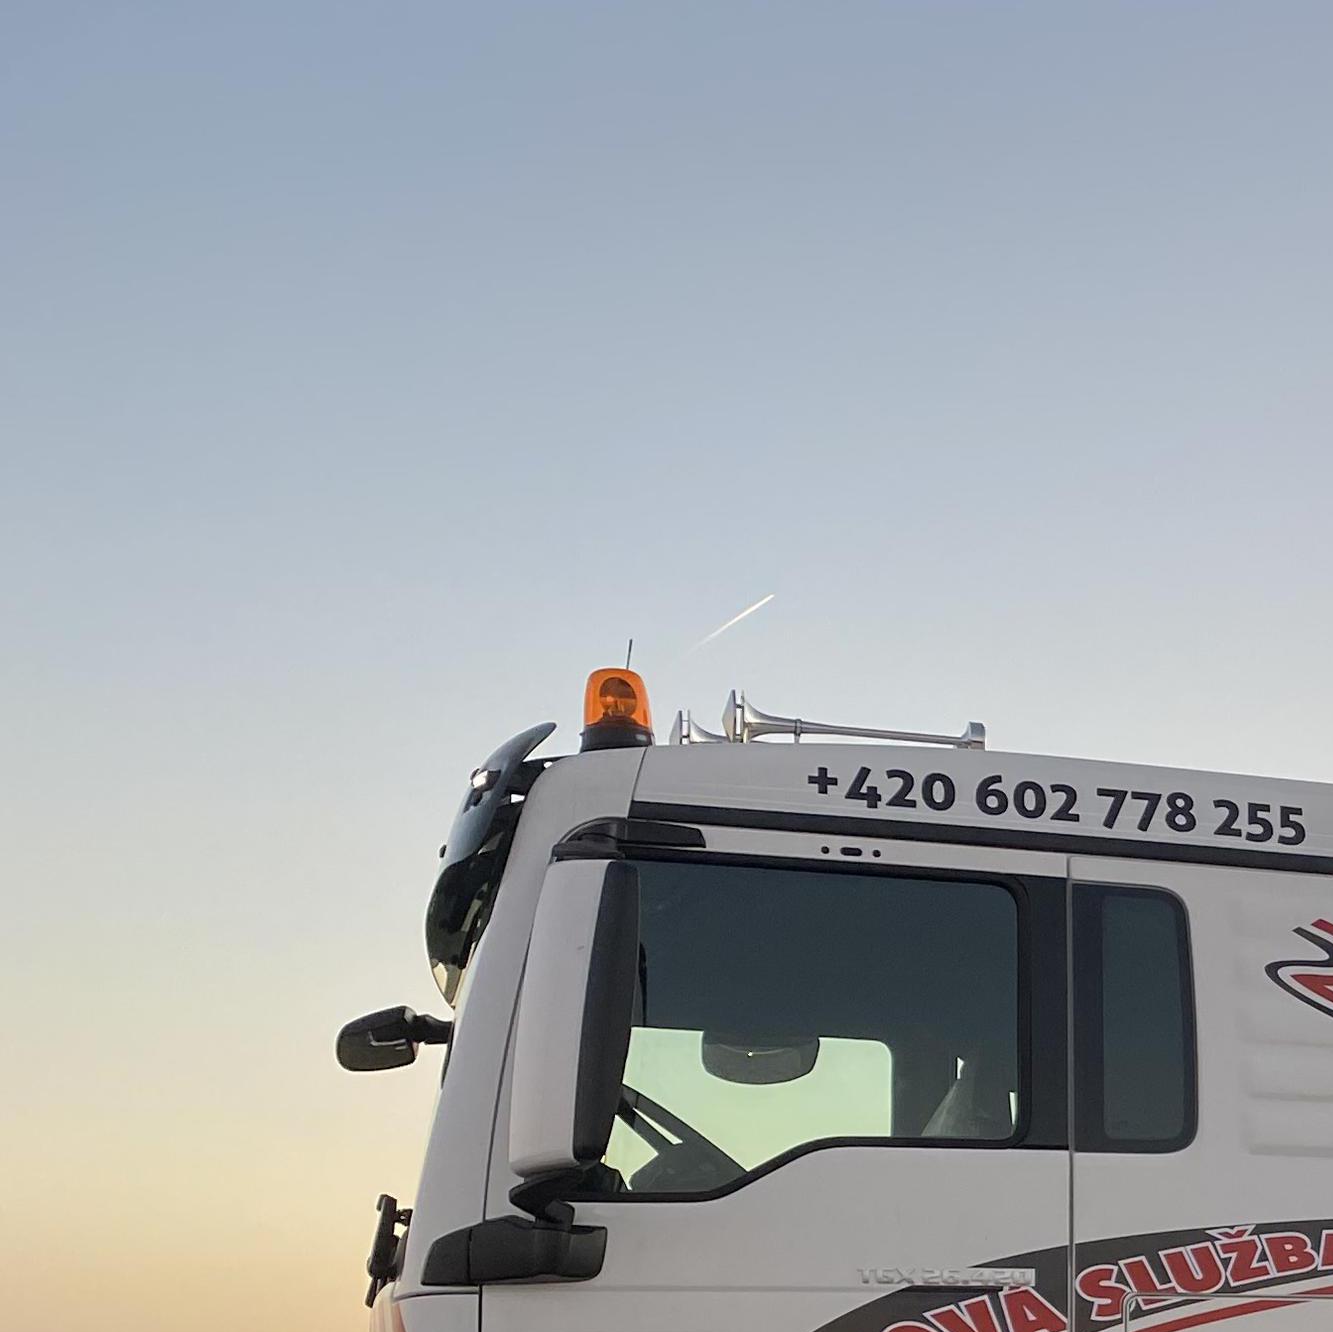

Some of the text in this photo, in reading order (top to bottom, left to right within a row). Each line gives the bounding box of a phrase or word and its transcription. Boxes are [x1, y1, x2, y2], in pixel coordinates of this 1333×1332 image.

[808, 766, 1307, 846] +420 602 778 255
[857, 1267, 1034, 1286] TGX 26.420
